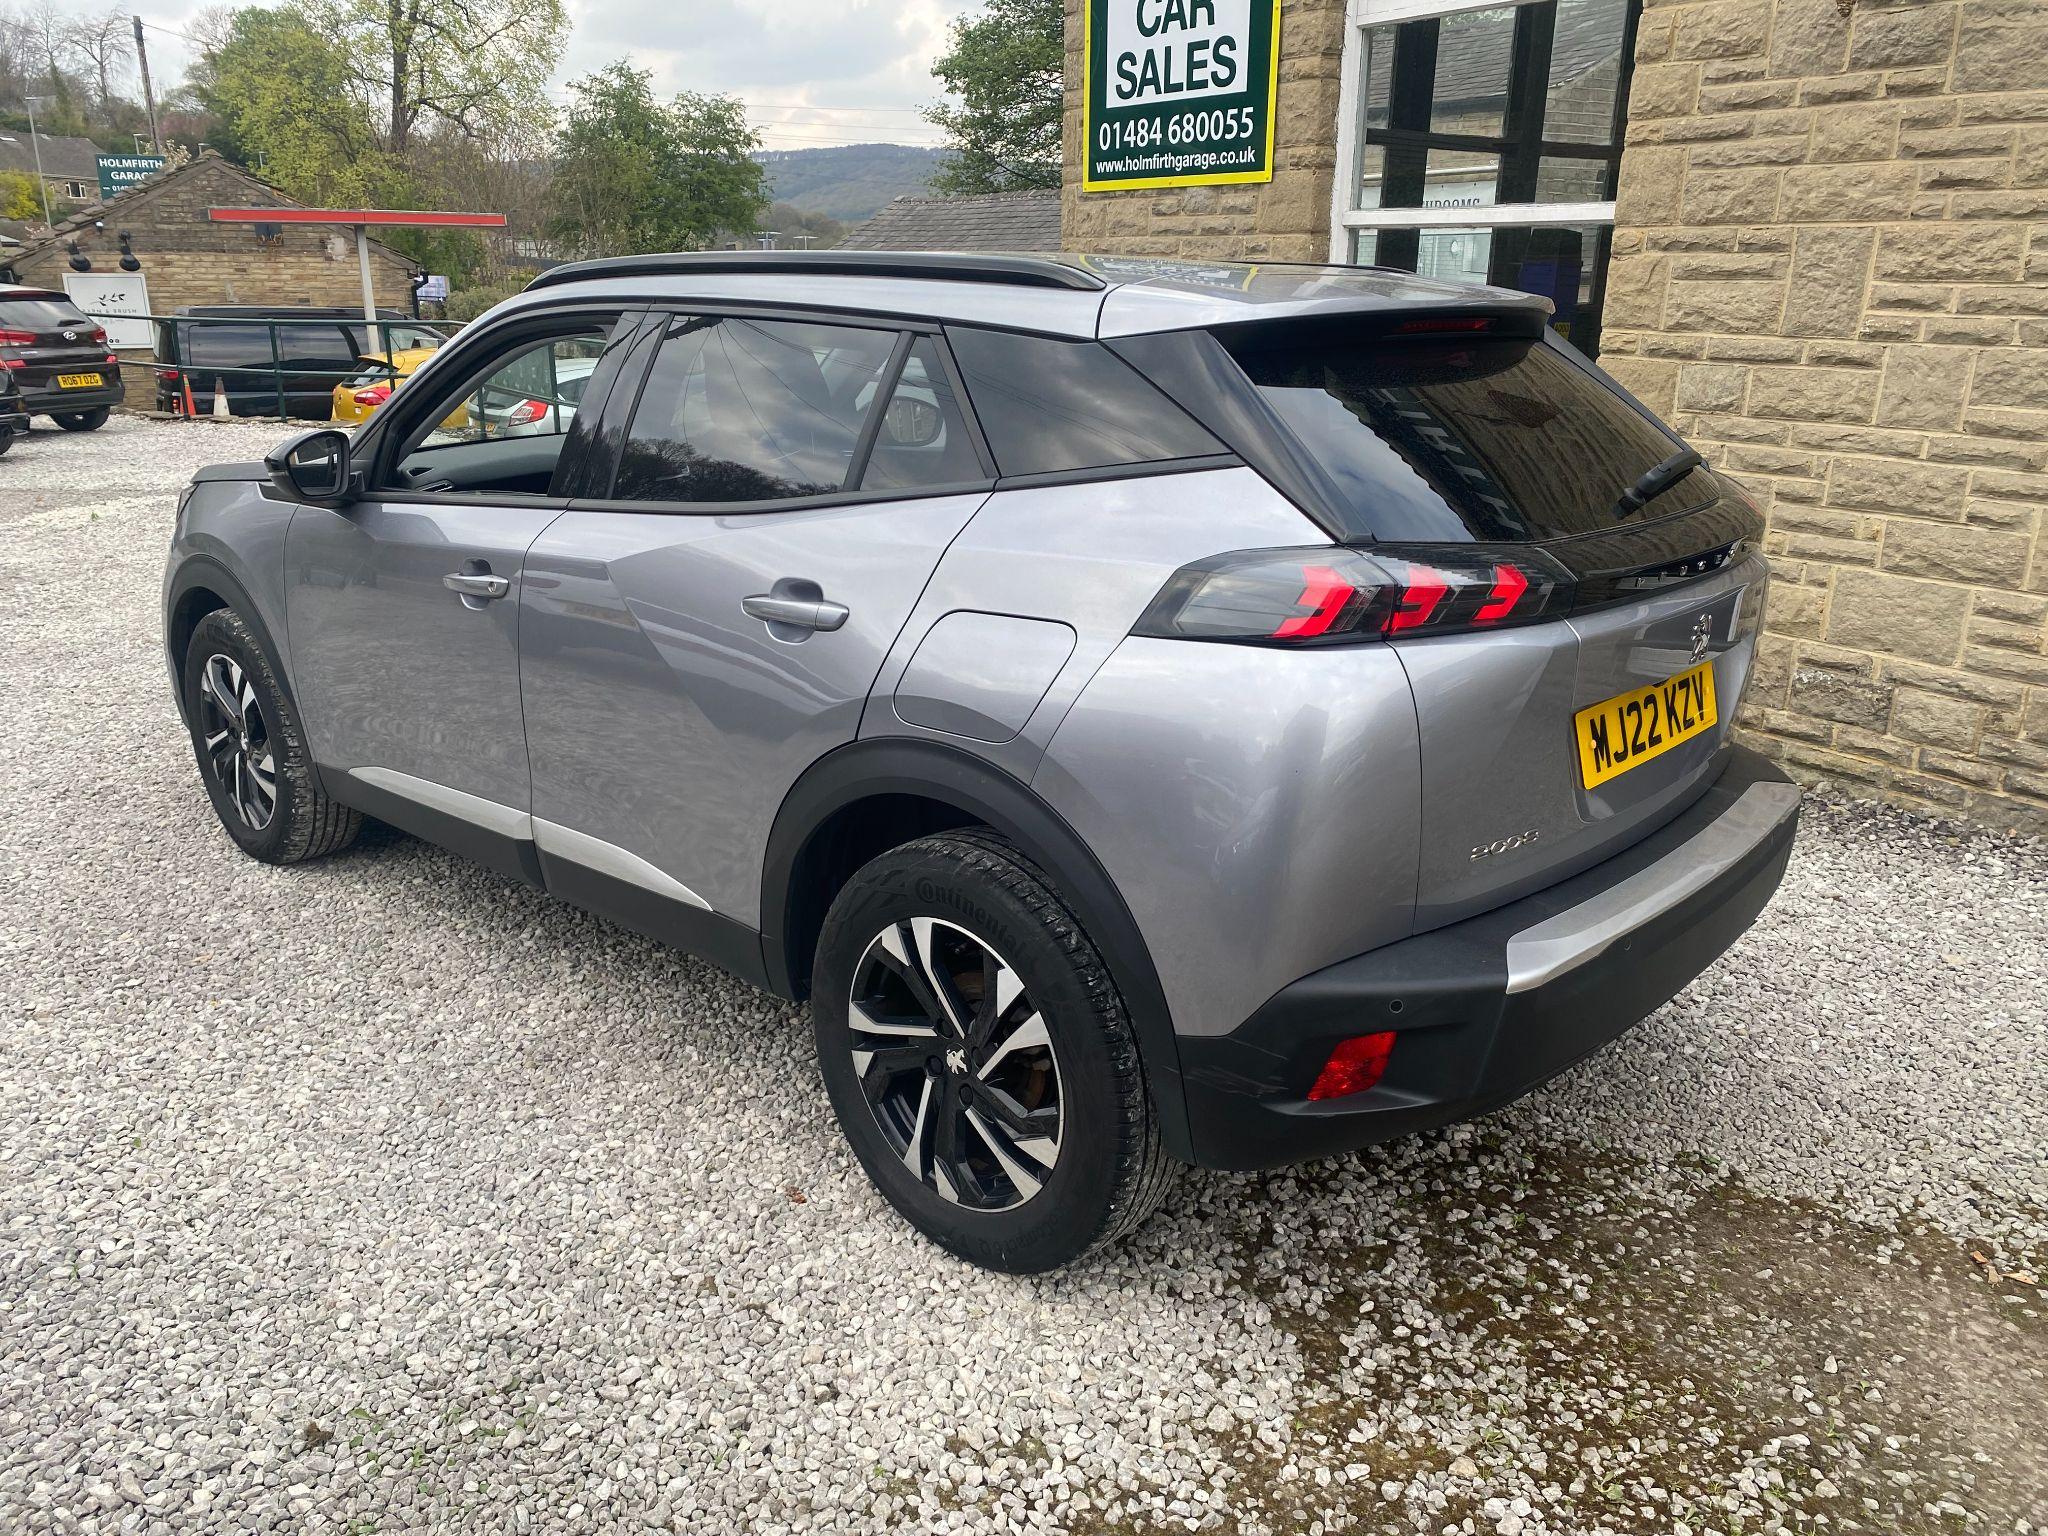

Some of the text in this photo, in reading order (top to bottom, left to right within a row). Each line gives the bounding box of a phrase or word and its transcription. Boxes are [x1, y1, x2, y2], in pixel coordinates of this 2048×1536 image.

[1136, 0, 1215, 38] CAR
[1115, 35, 1237, 100] SALES
[1099, 107, 1254, 151] 01484 680055
[98, 158, 163, 169] HOLMFIRTH
[110, 171, 154, 181] GARA
[1096, 146, 1256, 174] www.holmfirthgarage.co.uk
[1589, 670, 1705, 774] MJ22 KZV
